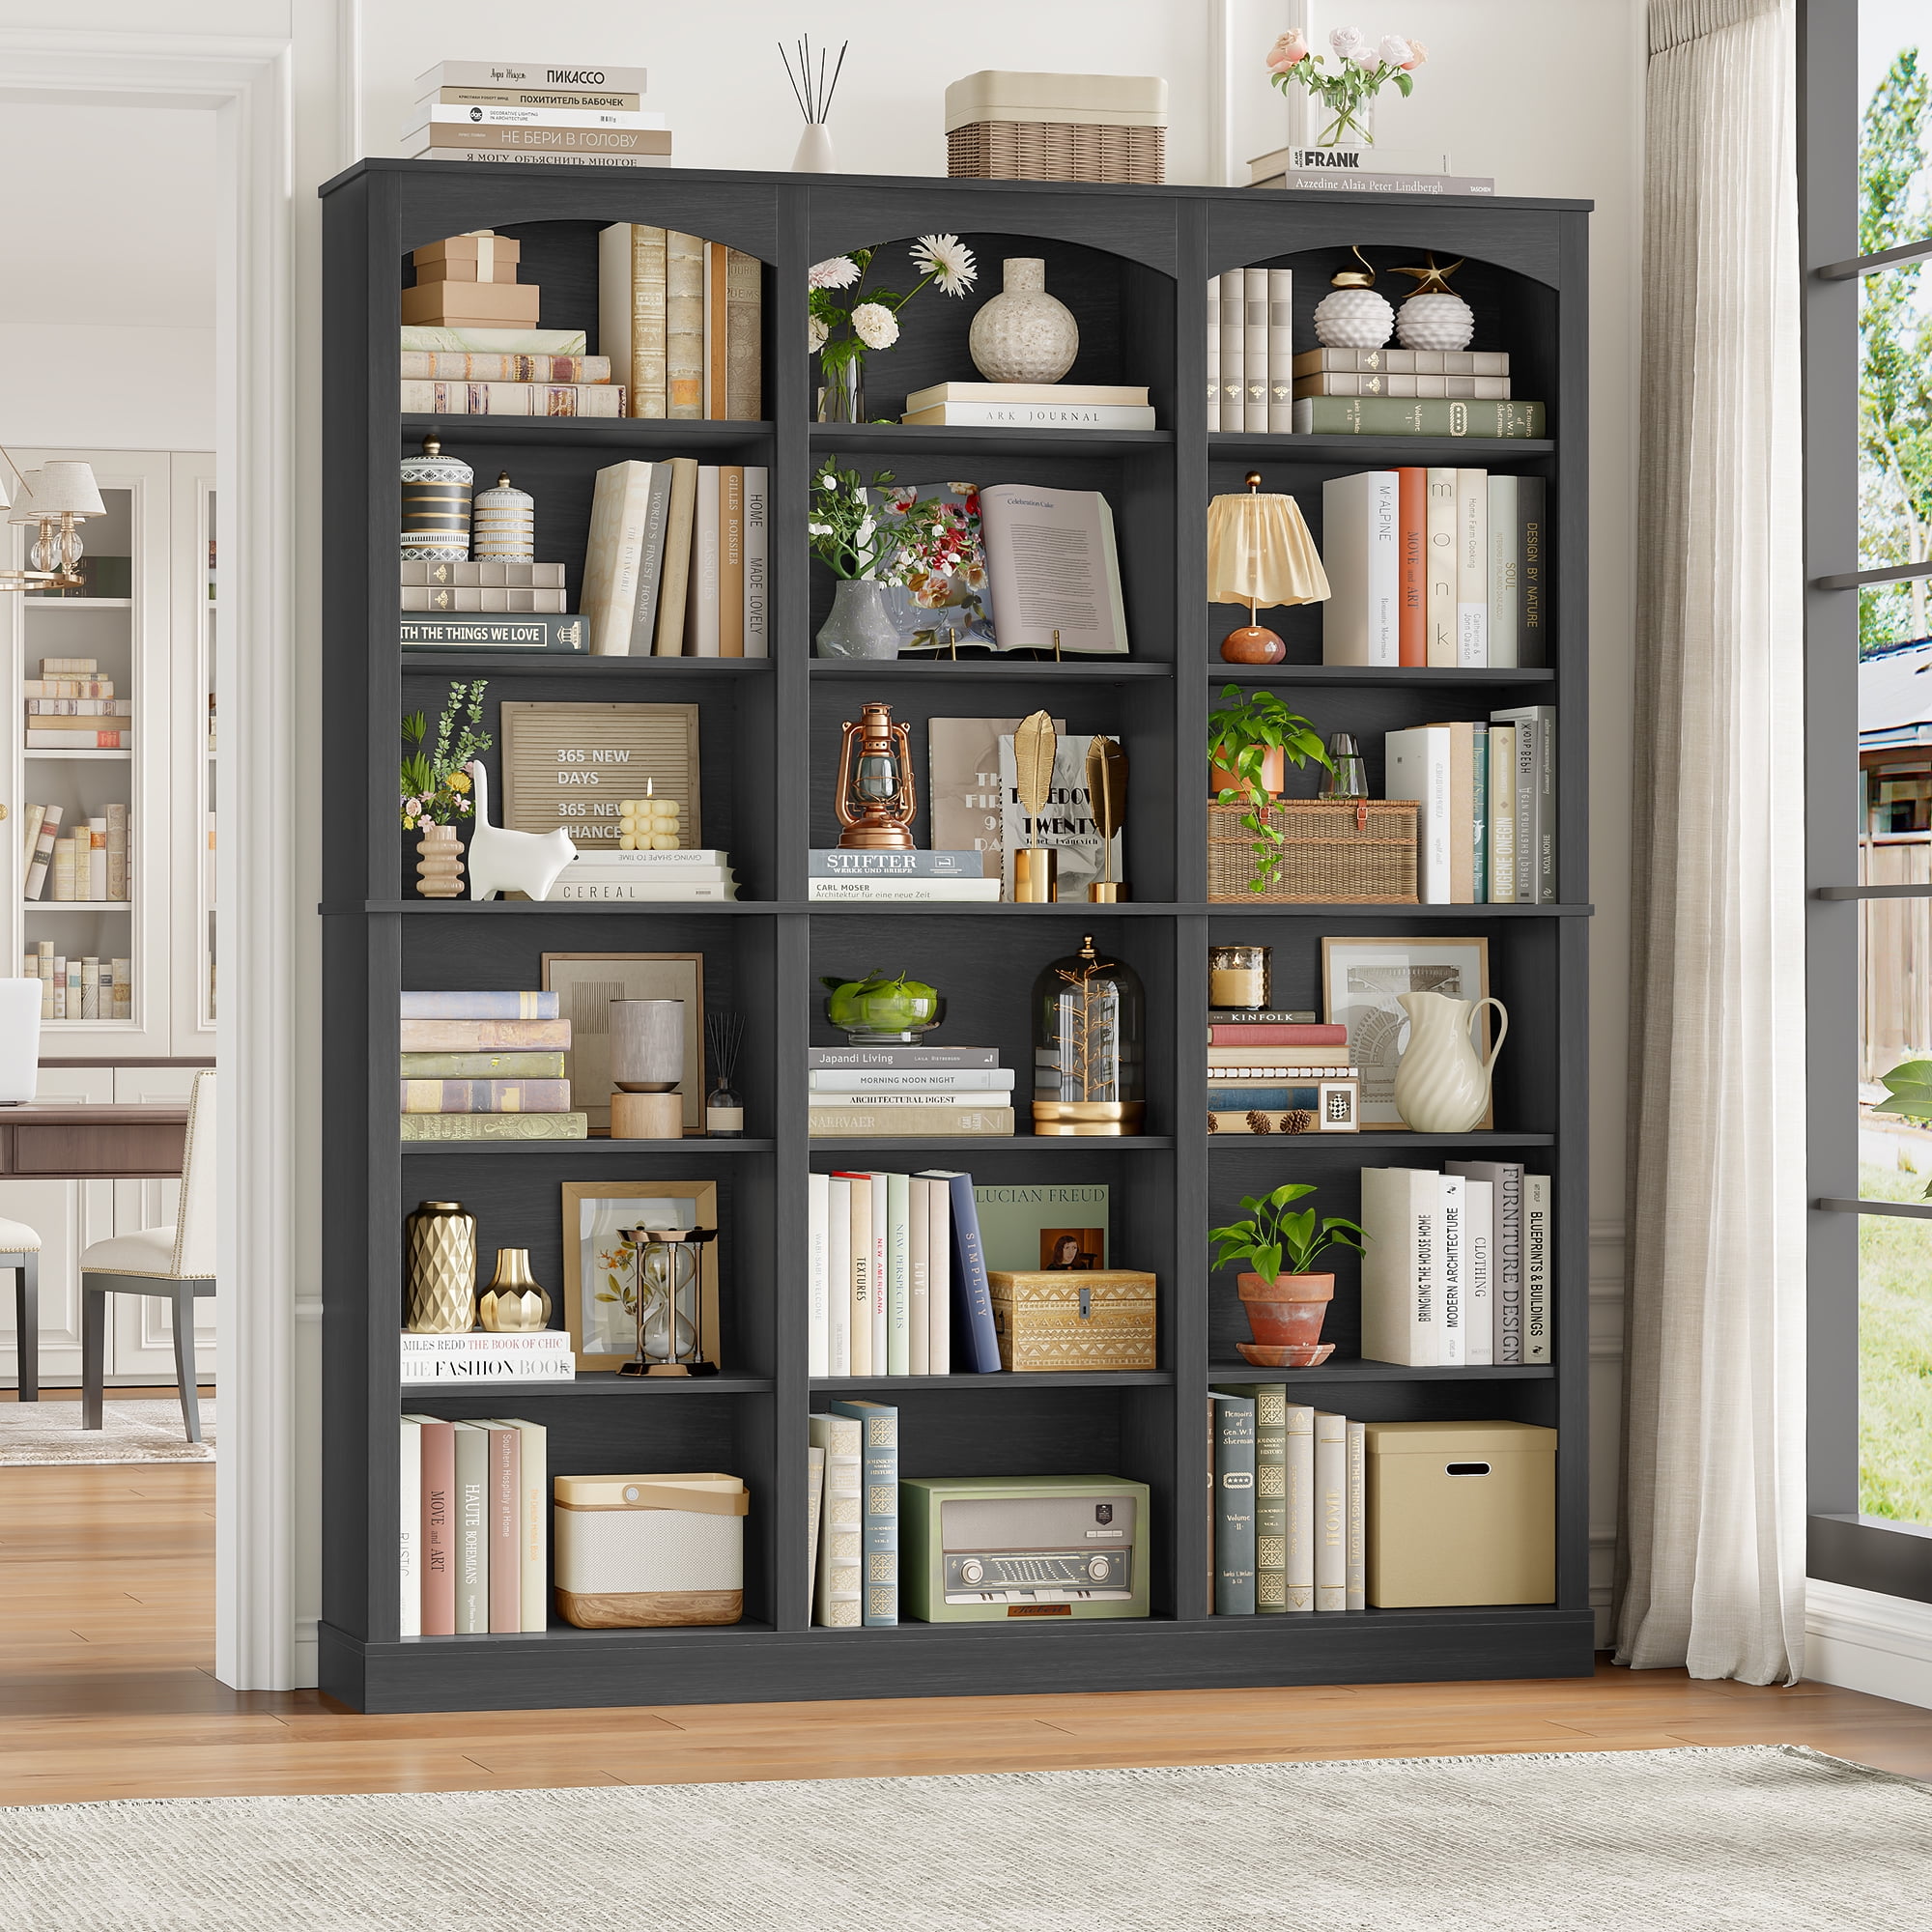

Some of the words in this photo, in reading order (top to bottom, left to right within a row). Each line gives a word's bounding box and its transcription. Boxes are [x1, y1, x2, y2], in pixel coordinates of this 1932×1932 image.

[547, 70, 606, 86] ПИКАССО
[520, 95, 580, 105] ПОХИТИТЕЛЬ
[582, 98, 624, 107] БАБОЧЕК
[501, 130, 520, 144] НЕ
[524, 131, 562, 145] БЕРИ
[566, 132, 577, 146] В
[580, 133, 639, 148] ГОЛОВУ
[467, 153, 474, 161] Я
[477, 154, 510, 162] МОГУ
[514, 155, 585, 166] ОБЪЯСНИТЬ
[588, 156, 638, 167] МНОГОЕ
[1304, 151, 1359, 168] FRANK
[1295, 178, 1339, 190] Azzedine
[1369, 181, 1393, 192] Peter
[1396, 182, 1444, 195] Lindbergh
[986, 411, 1016, 421] ARK
[1029, 411, 1100, 423] JOURNAL
[1414, 404, 1423, 432] Volume
[1496, 403, 1506, 438] Sherman
[1517, 417, 1525, 426] of
[728, 474, 739, 511] GILLES
[648, 491, 663, 539] WORLD'S
[750, 494, 763, 527] HOME
[1468, 497, 1477, 519] Home
[1468, 520, 1477, 538] Farm
[728, 519, 739, 565] BOISSIER
[1406, 531, 1419, 565] MOVE
[1526, 522, 1538, 562] DESIGN
[643, 544, 656, 581] FINEST
[1466, 540, 1477, 569] Cooking
[750, 557, 763, 589] MADE
[1406, 569, 1416, 582] and
[1505, 562, 1516, 590] SOUL
[1526, 566, 1538, 581] BY
[639, 584, 650, 623] HOMES
[1406, 585, 1419, 610] ART
[1526, 586, 1538, 629] NATURE
[750, 594, 763, 635] LOVELY
[401, 626, 418, 639] ITH
[420, 626, 443, 640] THE
[445, 627, 489, 641] THINGS
[491, 628, 508, 641] WE
[511, 628, 540, 641] LOVE
[556, 749, 585, 763] 365
[592, 750, 631, 763] NEW
[557, 771, 599, 784] DAYS
[557, 803, 586, 816] 365
[1022, 817, 1098, 835] TWENTY
[1495, 817, 1514, 855] ONEGIN
[1543, 834, 1551, 854] МОНЕ
[827, 854, 918, 868] STIFTER
[1543, 856, 1551, 874] КЛОД
[1495, 857, 1514, 896] EUGENE
[562, 886, 636, 898] CEREAL
[1232, 1013, 1294, 1022] KINFOLK
[819, 1053, 860, 1065] Japandi
[863, 1053, 894, 1065] Living
[849, 1095, 924, 1104] ARCHITECTURAL
[925, 1095, 956, 1104] DIGEST
[976, 1188, 1042, 1204] LUCIAN
[1049, 1188, 1105, 1204] FREUD
[1418, 1214, 1432, 1237] HOME
[1502, 1167, 1520, 1284] FURNITURE
[1418, 1238, 1432, 1264] HOUSE
[1446, 1208, 1459, 1283] ARCHITECTURE
[1530, 1211, 1543, 1272] BLUEPRINTS
[914, 1262, 925, 1296] LOVE
[965, 1232, 988, 1317] SIMPLITY
[1418, 1265, 1432, 1283] THE
[1474, 1236, 1487, 1298] CLOTHING
[856, 1257, 867, 1302] TEXTURES
[1418, 1285, 1432, 1322] BRINGING
[1446, 1285, 1459, 1328] MODERN
[1530, 1284, 1543, 1337] BUILDINGS
[1502, 1290, 1520, 1363] DESIGN
[403, 1339, 435, 1351] MILES
[438, 1339, 466, 1350] REDD
[469, 1339, 489, 1350] THE
[492, 1338, 520, 1350] BOOK
[522, 1338, 535, 1349] OF
[538, 1337, 563, 1349] CHIC
[403, 1360, 431, 1377] THE
[436, 1360, 514, 1377] FASHION
[519, 1359, 571, 1376] BOOK
[502, 1434, 512, 1468] Southern
[1223, 1436, 1254, 1445] Sherman
[1352, 1435, 1361, 1462] WITH
[1352, 1463, 1361, 1481] THE
[430, 1491, 445, 1526] MOVE
[466, 1484, 480, 1526] HAUTE
[502, 1505, 511, 1514] at
[1352, 1484, 1361, 1519] THINGS
[502, 1516, 511, 1538] Home
[1227, 1514, 1251, 1522] Volume
[1352, 1520, 1361, 1535] WE
[430, 1531, 440, 1545] and
[1352, 1539, 1361, 1560] LOVE
[430, 1548, 445, 1573] ART
[466, 1530, 477, 1585] BOHEMIANS
